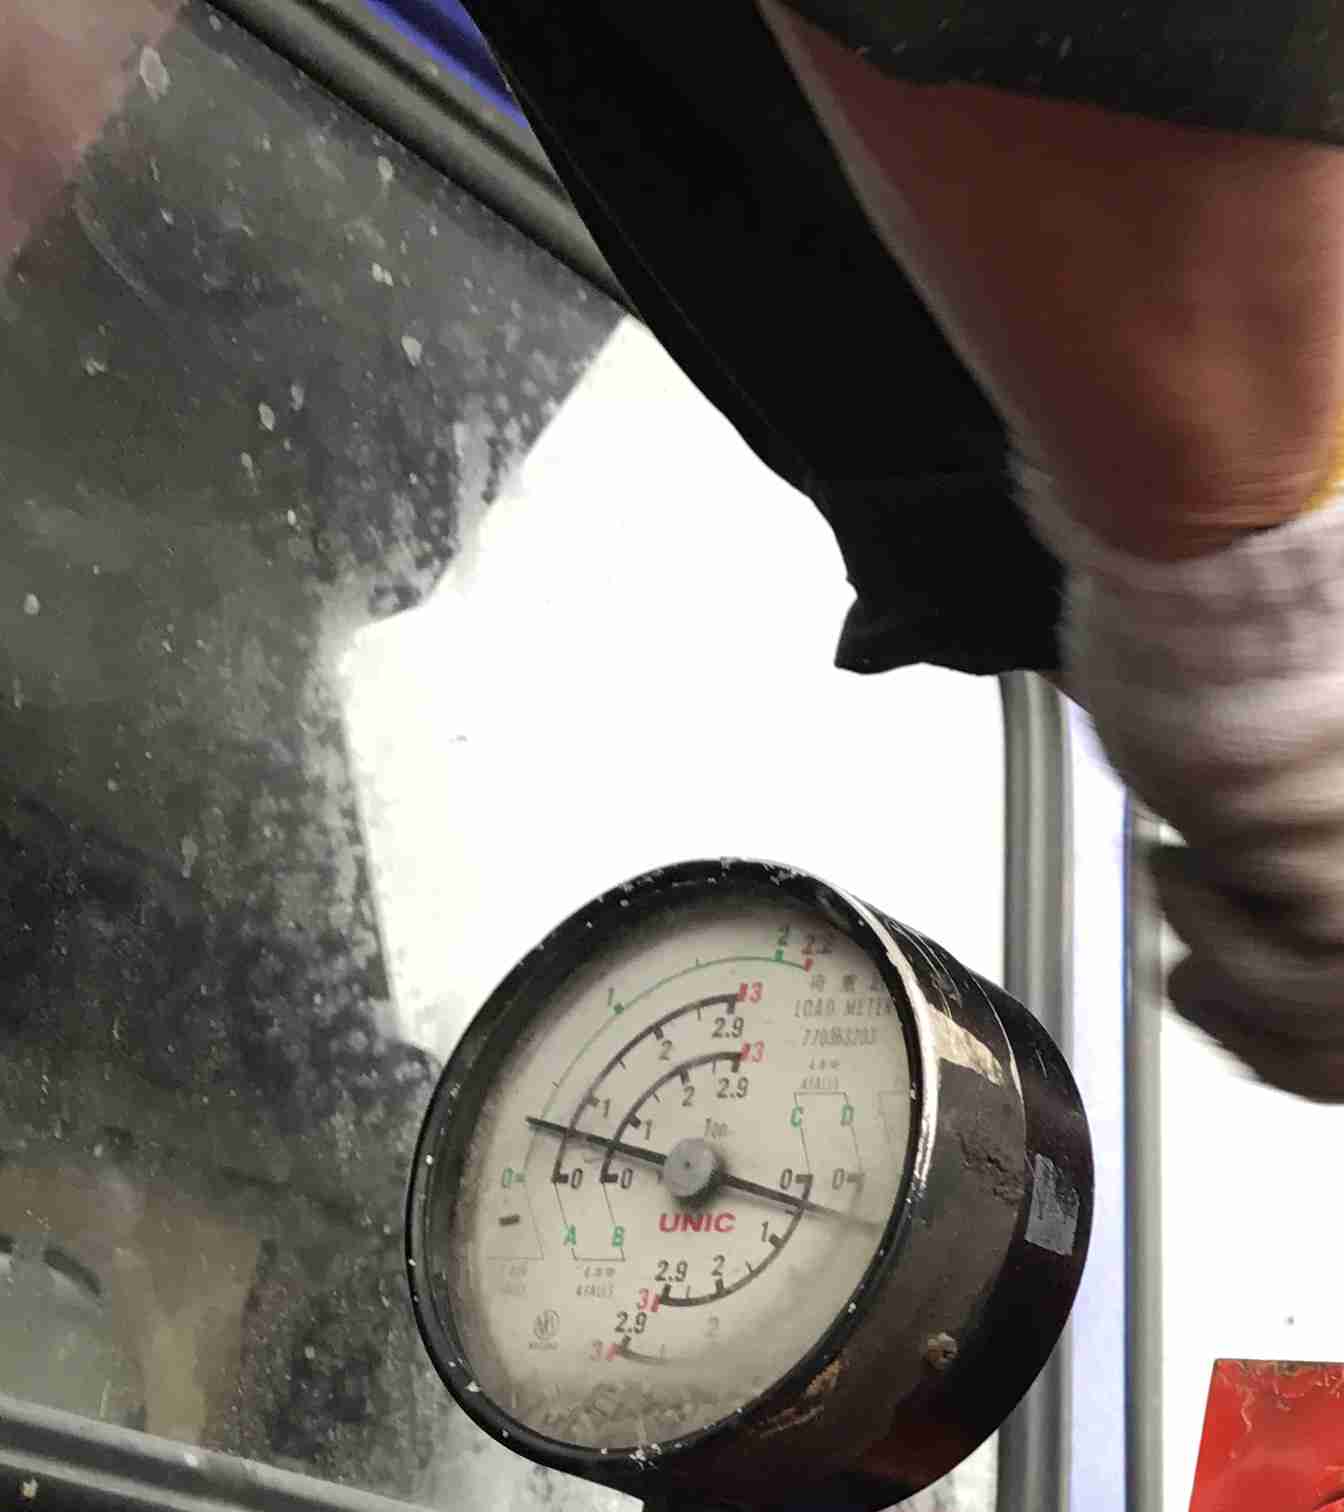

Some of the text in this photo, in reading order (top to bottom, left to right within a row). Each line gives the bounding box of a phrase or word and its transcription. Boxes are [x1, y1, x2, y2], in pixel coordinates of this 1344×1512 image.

[750, 981, 764, 1004] 3
[711, 1016, 745, 1039] 2.9
[658, 1039, 673, 1061] 2
[752, 1040, 766, 1063] 3
[681, 1085, 696, 1107] 2
[716, 1076, 750, 1100] 2.9
[602, 1097, 611, 1119] 1
[790, 1104, 804, 1128] C
[839, 1104, 855, 1127] D
[644, 1119, 653, 1141] 1
[570, 1168, 584, 1190] 0
[620, 1168, 634, 1190] 0
[779, 1168, 793, 1190] 0
[831, 1168, 845, 1190] 0
[658, 1211, 737, 1233] UNIC
[760, 1221, 769, 1243] 1
[562, 1224, 577, 1247] A
[611, 1224, 626, 1248] B
[654, 1259, 689, 1283] 2.9
[711, 1254, 726, 1277] 2
[636, 1287, 650, 1310] 3
[613, 1311, 648, 1335] 2.9
